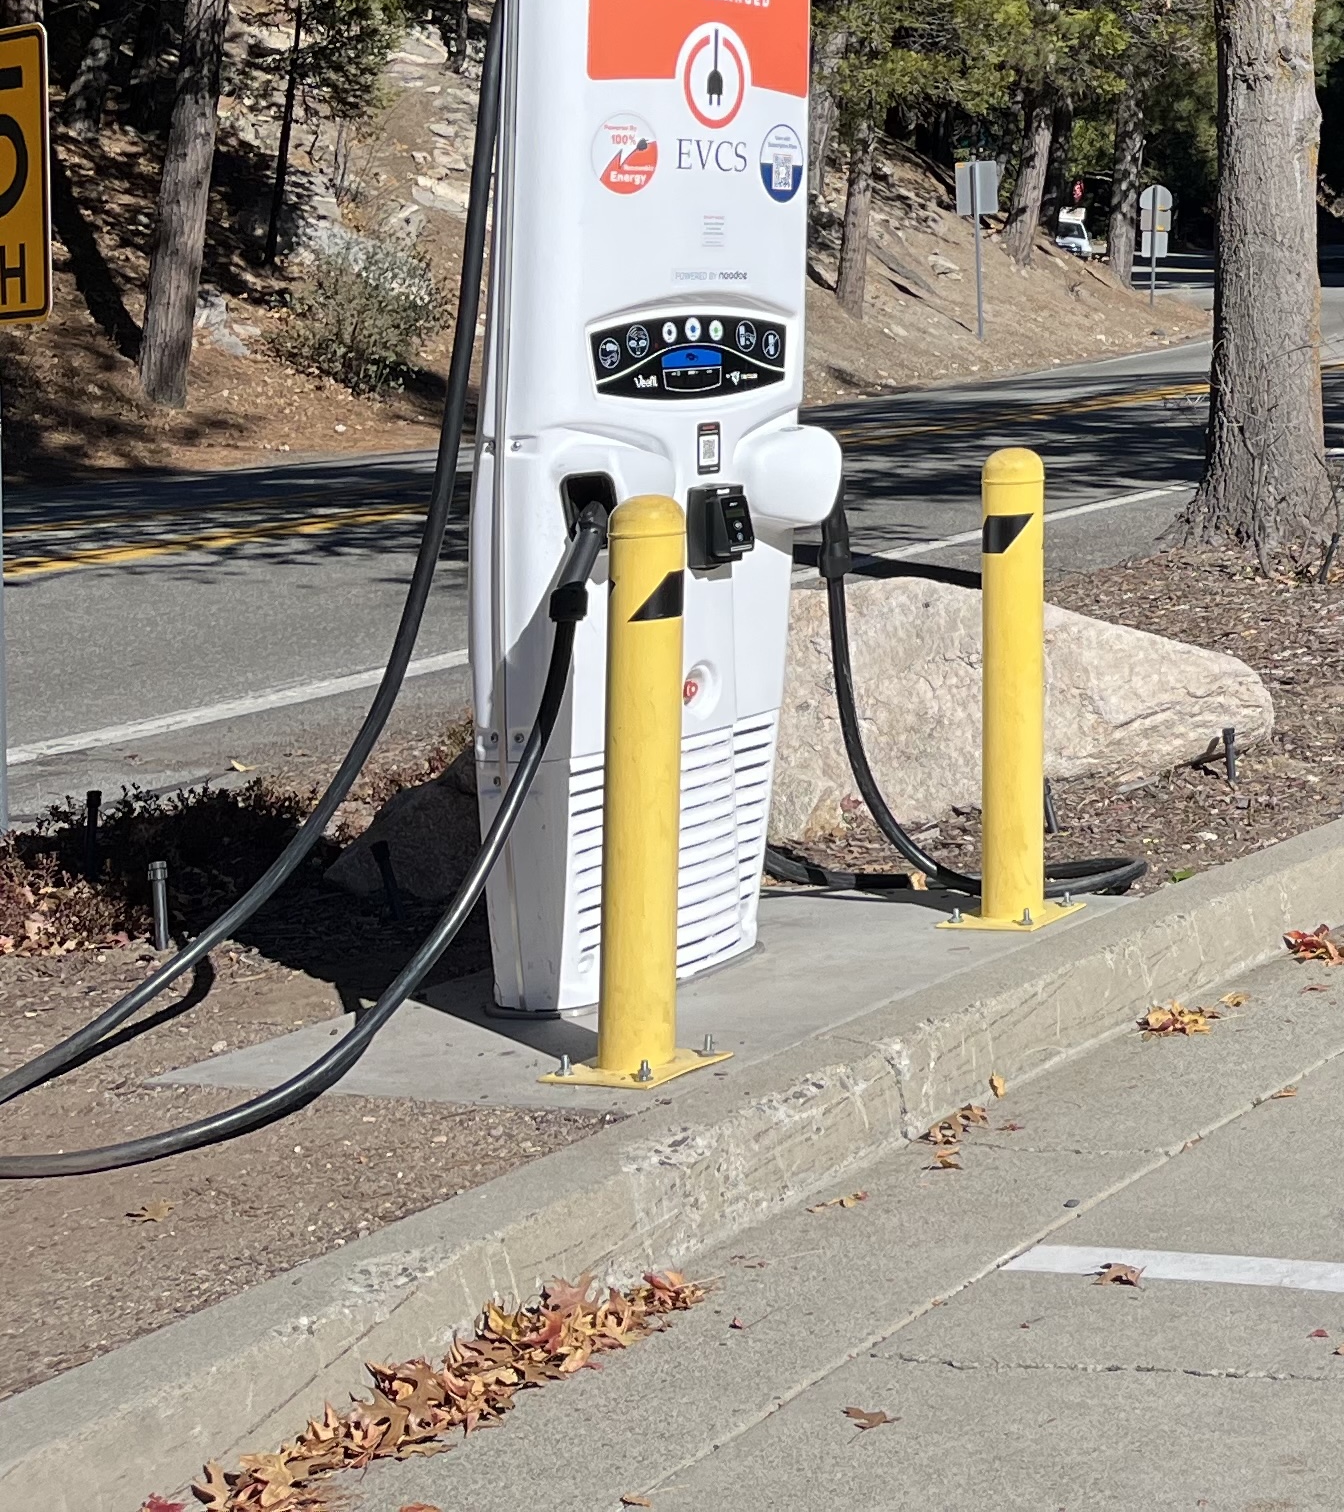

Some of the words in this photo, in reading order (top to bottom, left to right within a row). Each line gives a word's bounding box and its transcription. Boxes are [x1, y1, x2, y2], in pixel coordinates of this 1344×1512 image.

[611, 134, 636, 145] 100%
[676, 138, 747, 172] EVCS
[610, 171, 647, 185] Energy
[675, 272, 706, 281] POWERED
[709, 272, 718, 280] BY
